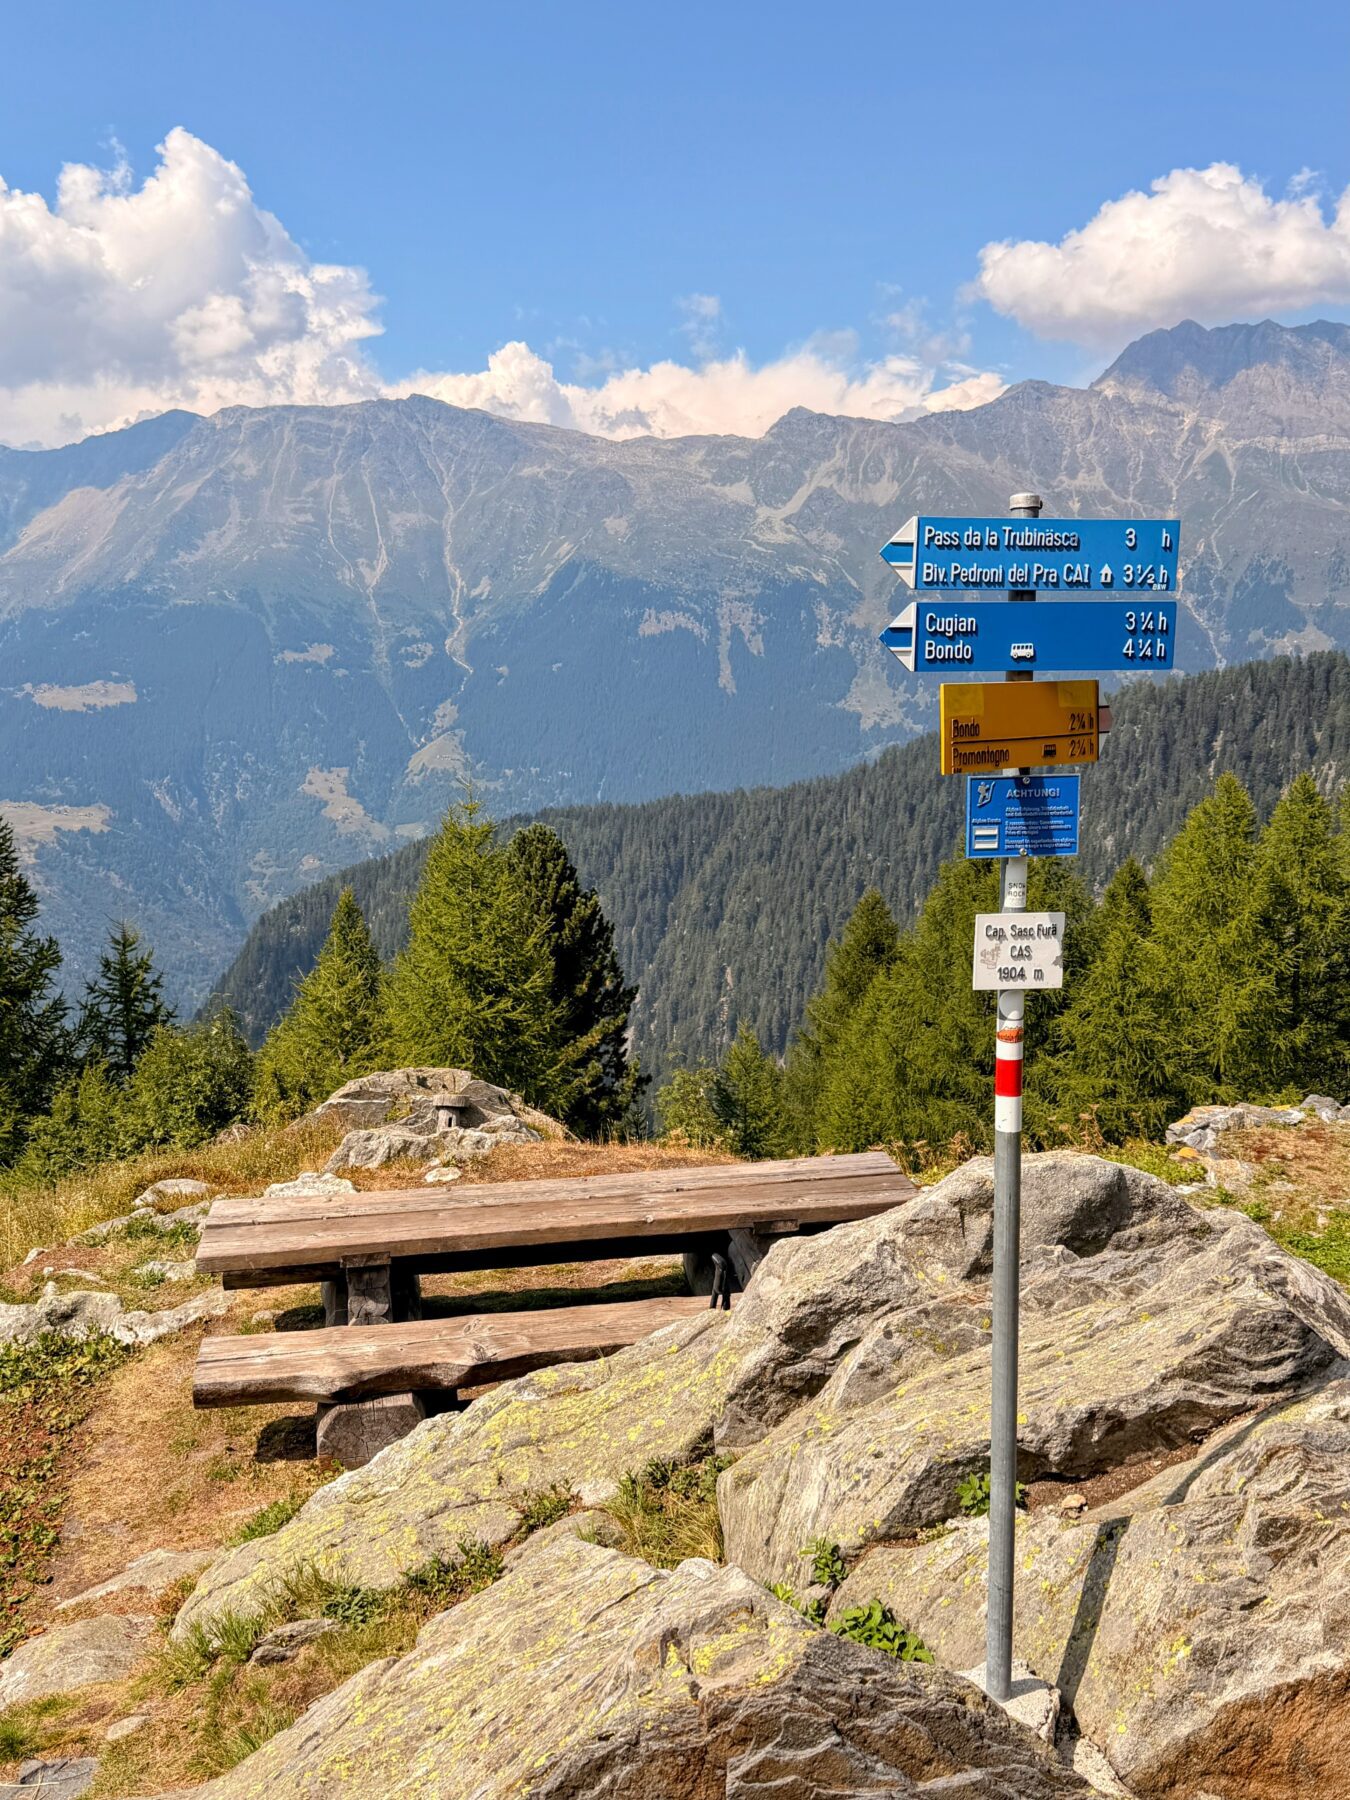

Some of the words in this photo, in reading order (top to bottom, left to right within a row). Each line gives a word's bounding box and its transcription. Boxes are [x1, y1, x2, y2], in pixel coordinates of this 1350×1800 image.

[924, 525, 960, 546] Pass
[964, 525, 981, 546] da
[985, 526, 998, 546] la
[1002, 526, 1079, 547] Trubinäsca
[1125, 528, 1136, 547] 3
[1161, 528, 1171, 548] h
[922, 563, 947, 583] Biv.
[950, 563, 1003, 583] Pedroni
[1008, 563, 1029, 583] del
[1033, 563, 1057, 583] Pra
[1063, 563, 1090, 583] CAI
[1159, 564, 1168, 583] h
[925, 613, 976, 637] Cugian
[1158, 611, 1167, 631] h
[924, 640, 972, 660] Bondo
[1156, 638, 1165, 657] h
[951, 718, 980, 738] Bondo
[951, 746, 1009, 767] Promontogno
[1006, 788, 1060, 798] ACHTUNG!
[985, 925, 1006, 940] Cap.
[1010, 925, 1034, 938] Sasc
[1037, 924, 1057, 936] Furä
[1010, 945, 1031, 958] CAS
[997, 967, 1026, 979] 1904
[1033, 968, 1043, 979] m
